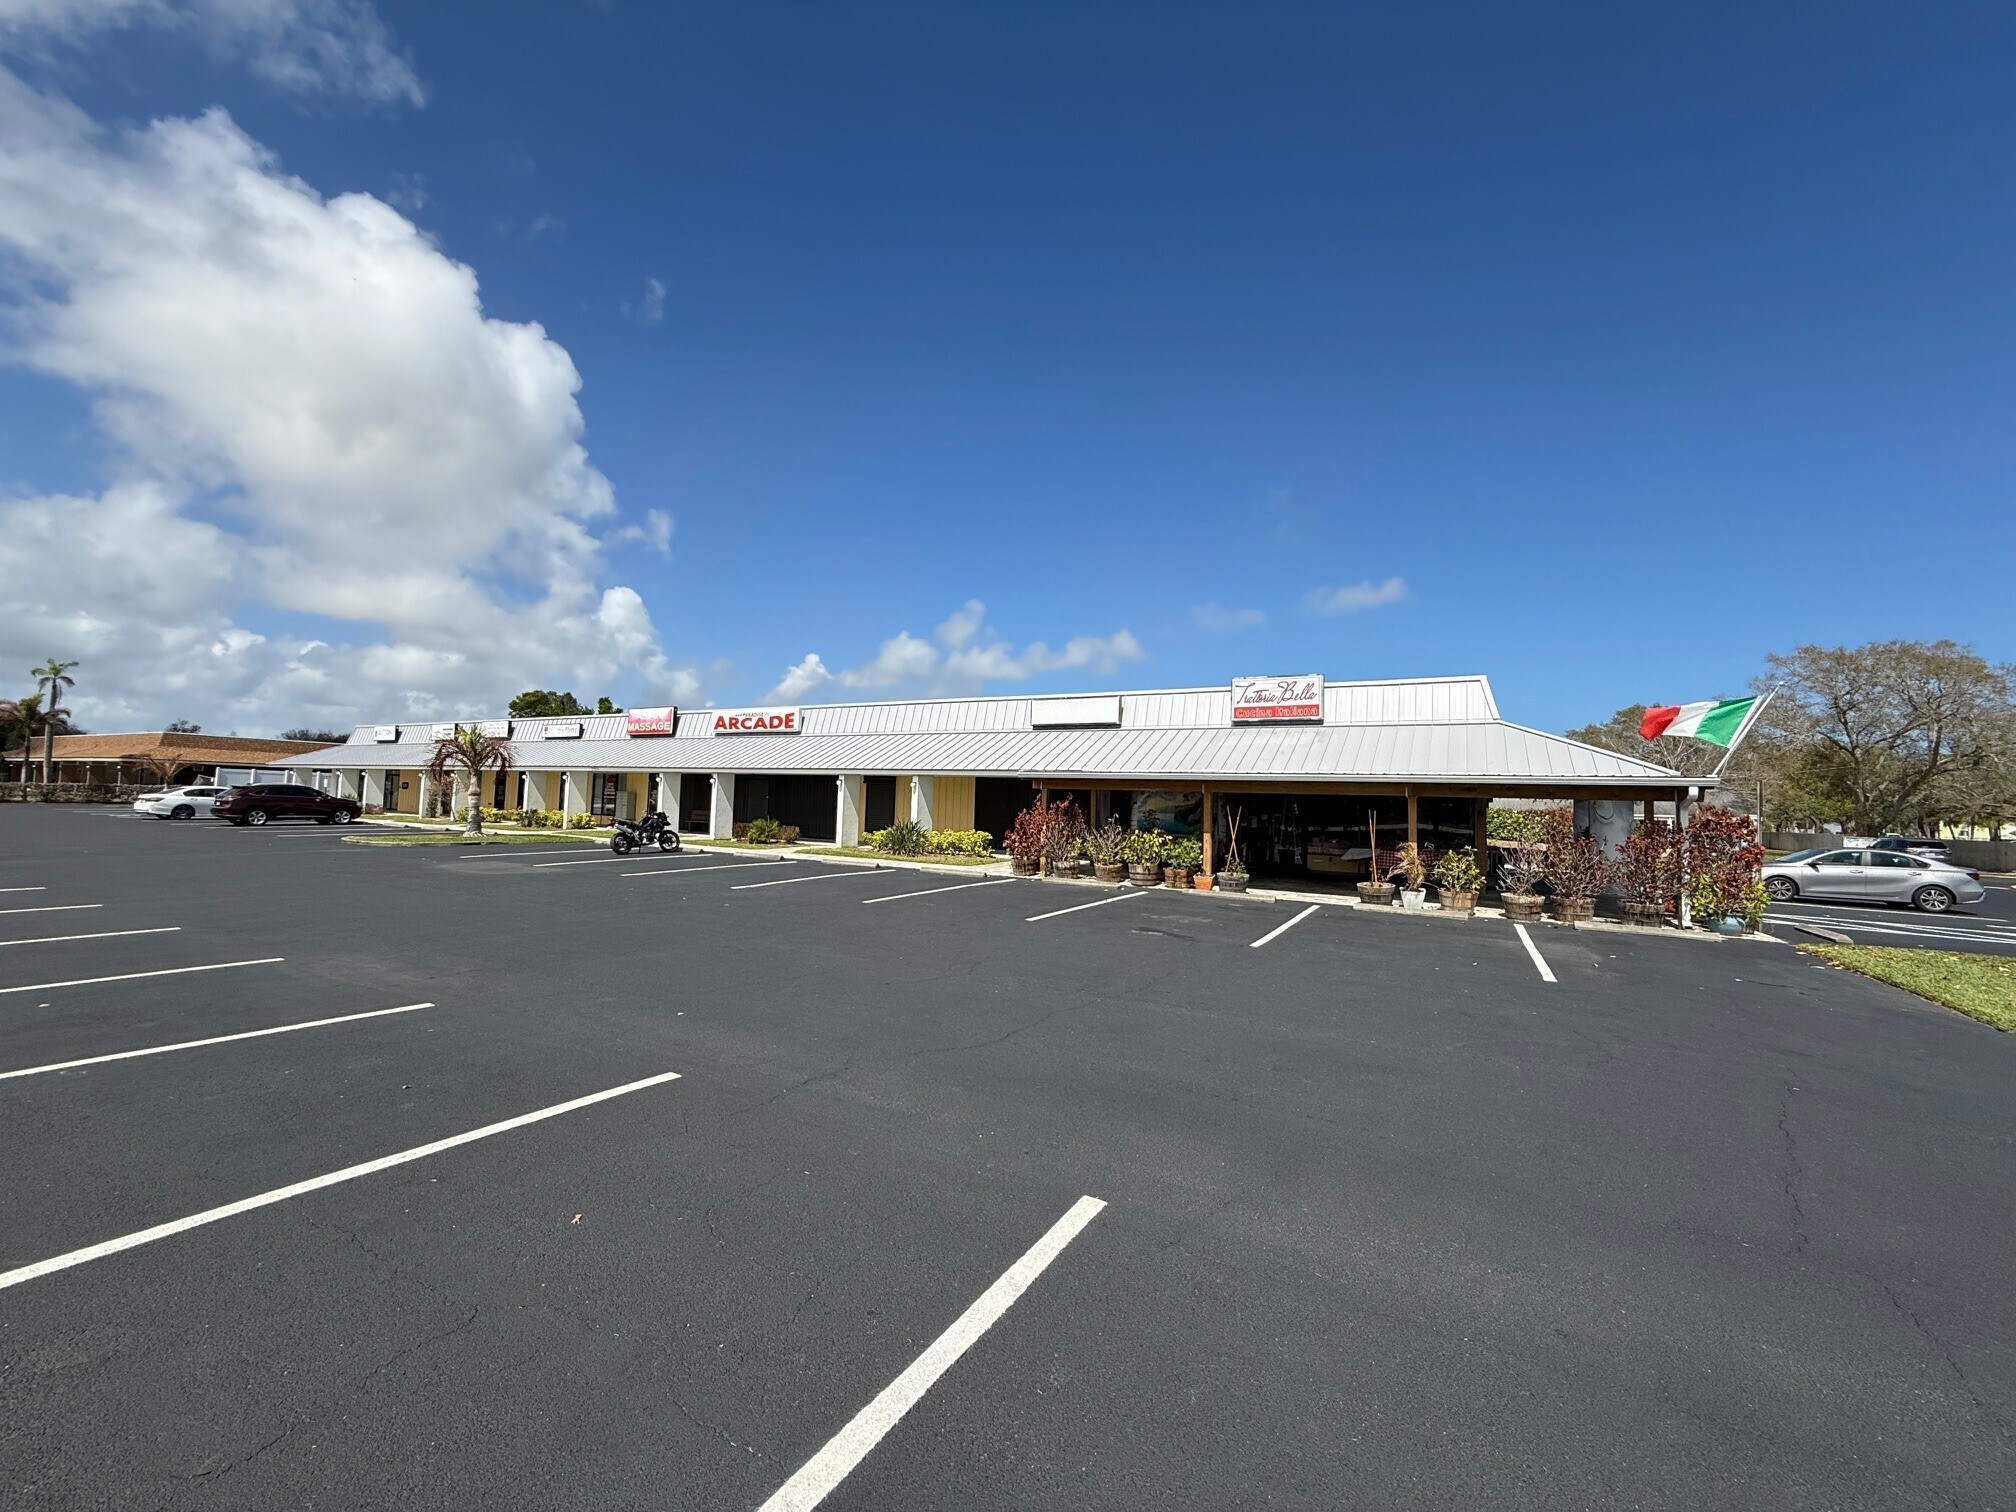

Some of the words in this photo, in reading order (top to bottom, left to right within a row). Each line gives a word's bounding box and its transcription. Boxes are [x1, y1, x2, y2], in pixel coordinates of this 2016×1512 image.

[1235, 682, 1277, 704] Trattoria
[1277, 681, 1317, 704] Bella
[628, 721, 671, 731] MASSAGE
[714, 712, 795, 730] ARCADE
